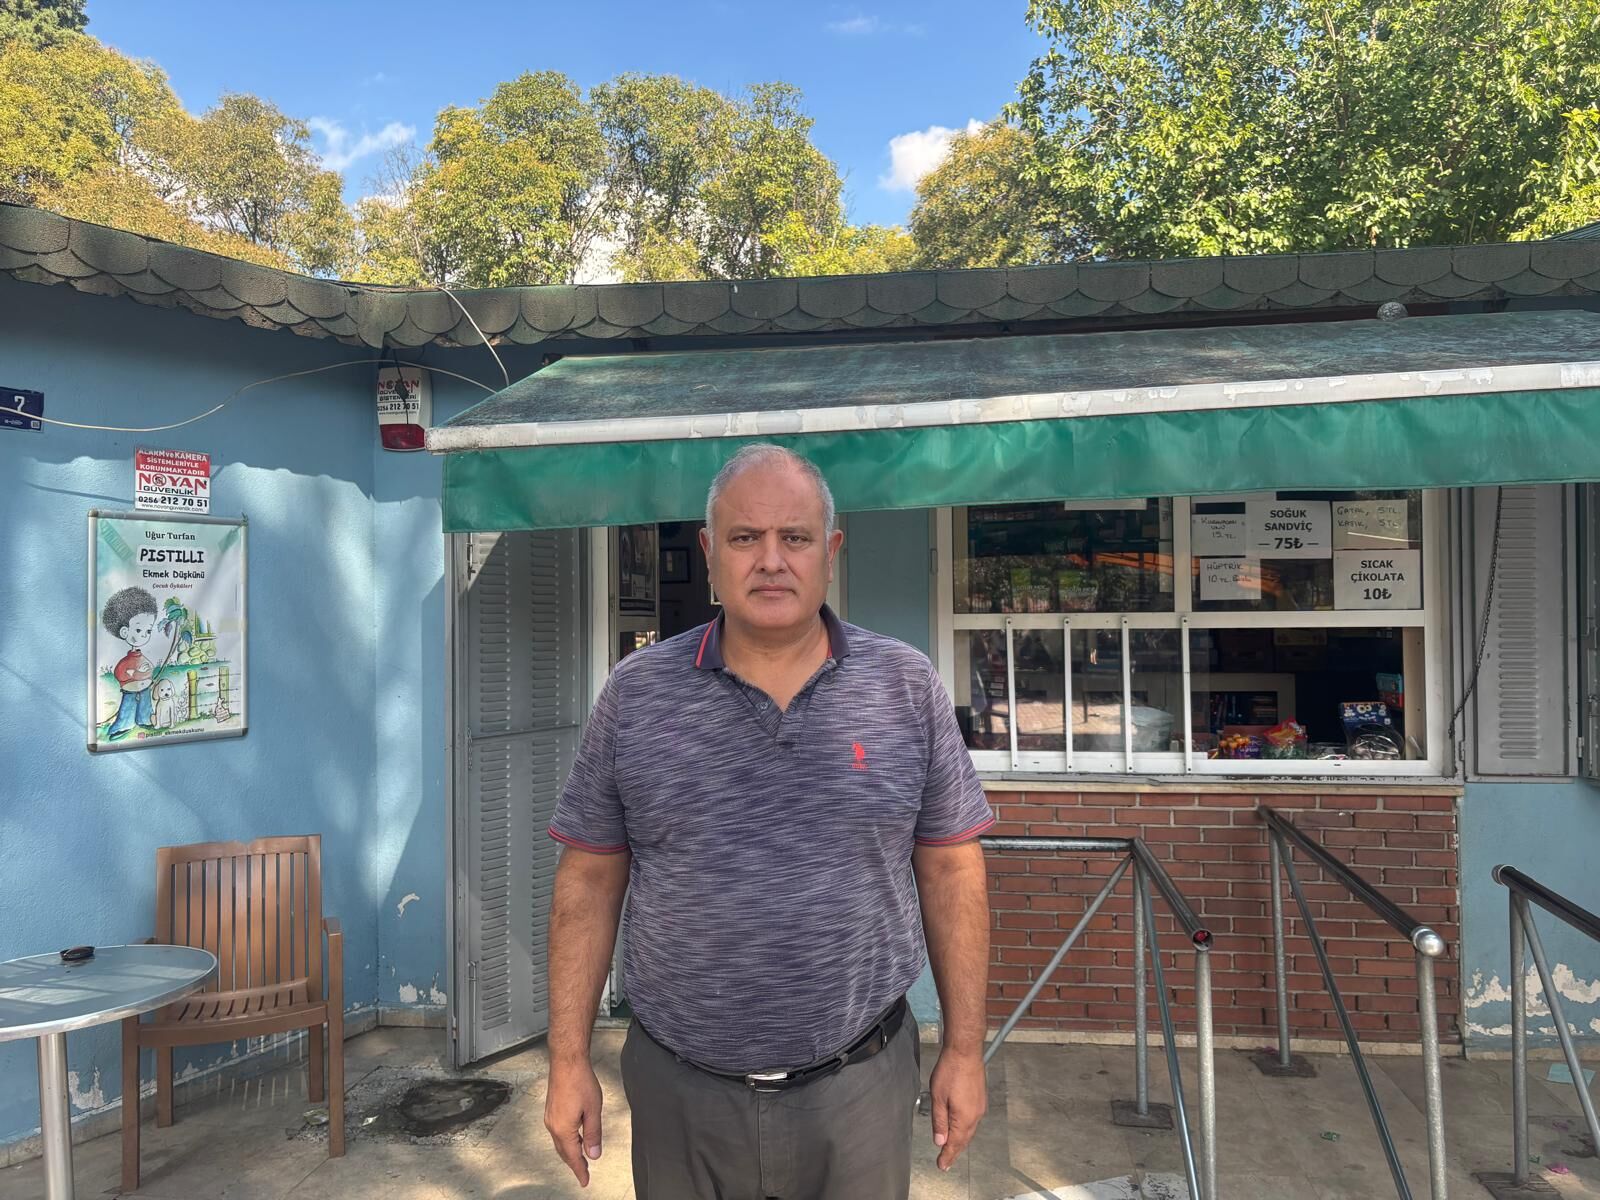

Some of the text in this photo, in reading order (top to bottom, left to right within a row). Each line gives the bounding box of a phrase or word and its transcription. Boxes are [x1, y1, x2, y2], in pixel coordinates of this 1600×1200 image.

[14, 395, 25, 412] 7
[389, 402, 401, 410] 212
[411, 402, 419, 410] 51
[174, 452, 208, 462] KAMERA
[146, 457, 199, 469] SİSTEMLERİYLE
[139, 464, 206, 476] KORUNMAKTADIR
[138, 472, 207, 495] NOYAN
[143, 484, 194, 496] GÜVENLİK
[138, 496, 208, 507] 0256 212 70 51
[1269, 507, 1307, 518] SOĞUK
[1264, 521, 1313, 533] SANDVİÇ
[145, 530, 196, 540] Uğur Turfan
[1274, 537, 1304, 549] 75₺
[140, 548, 205, 564] PISTILLI
[1360, 560, 1394, 569] SICAK
[142, 569, 205, 580] Ekmek Düşkünü
[1208, 575, 1218, 583] 10
[1350, 573, 1405, 584] ÇİKOLATA
[1363, 588, 1392, 600] 10₺
